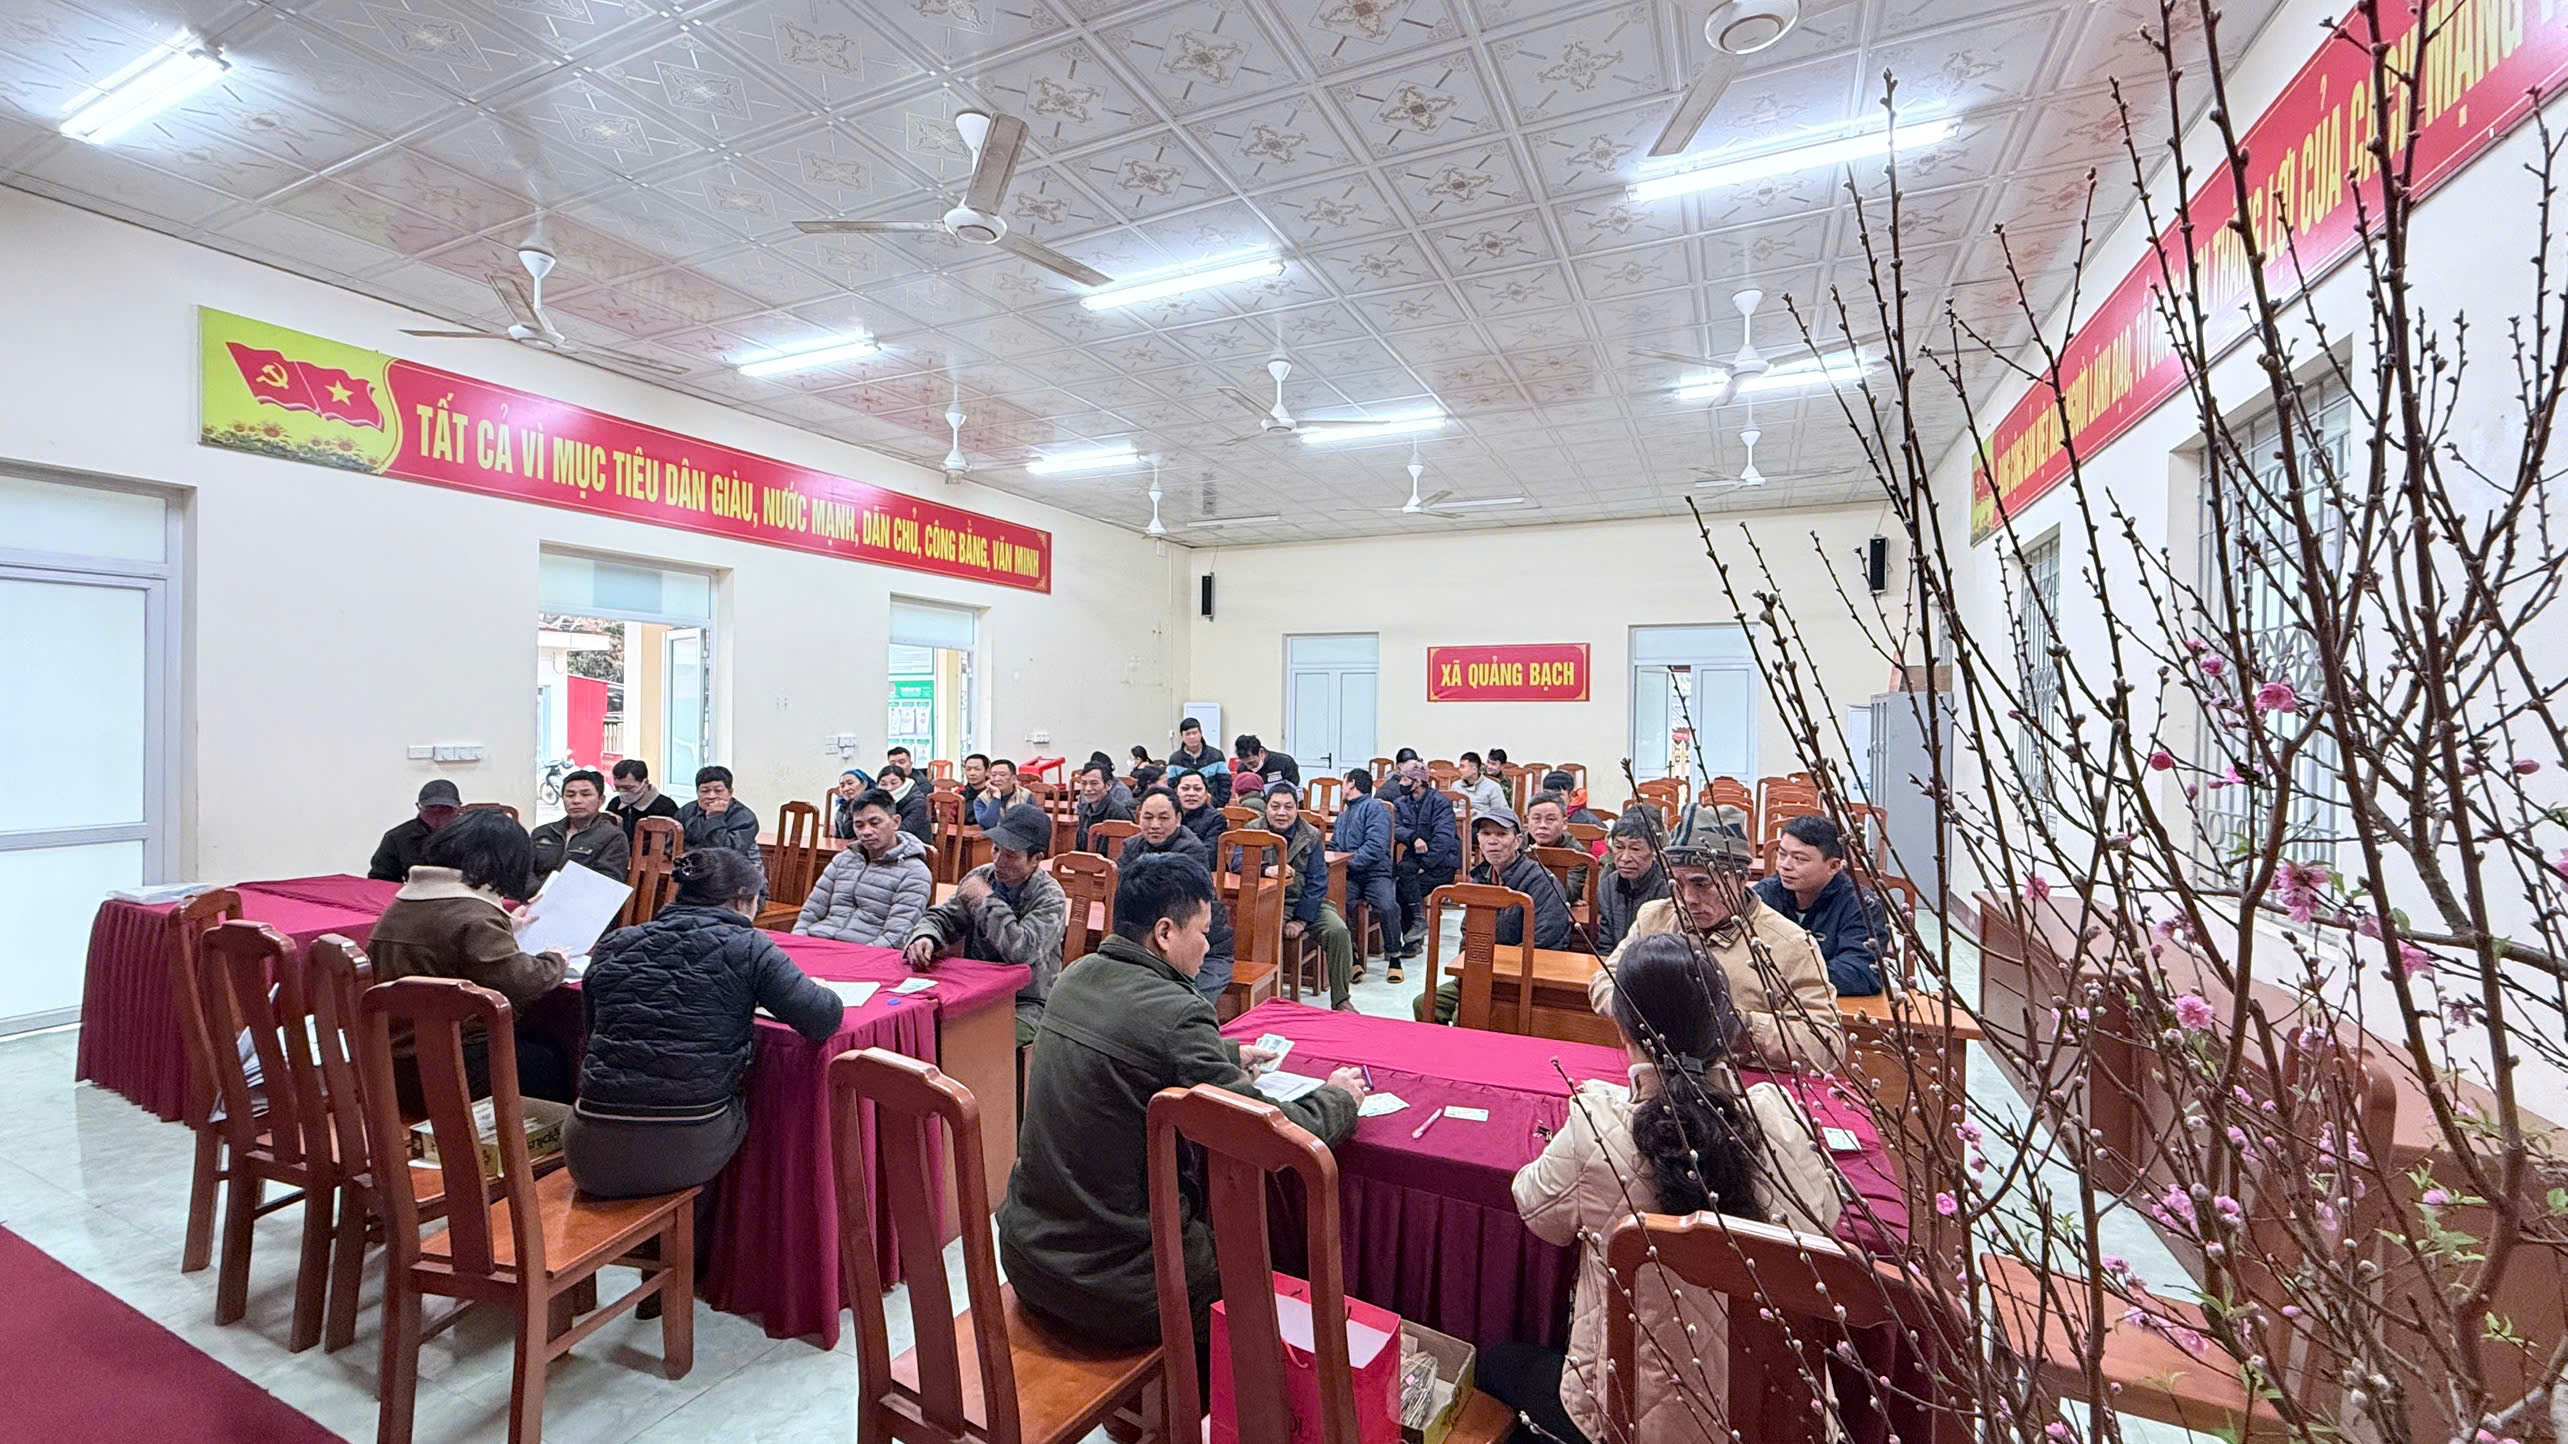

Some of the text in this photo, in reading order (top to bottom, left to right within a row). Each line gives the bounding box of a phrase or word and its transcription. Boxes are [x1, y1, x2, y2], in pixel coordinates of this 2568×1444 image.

[2301, 74, 2342, 236] CỦA
[416, 392, 1039, 578] TẤT CẢ VÌ MỤC TIÊU DÂN GIÀU, NƯỚC MẠNH, DÂN CHỦ, CÔNG BẰNG, VĂN MINH
[1440, 655, 1575, 691] XÃ QUẢNG BẠCH
